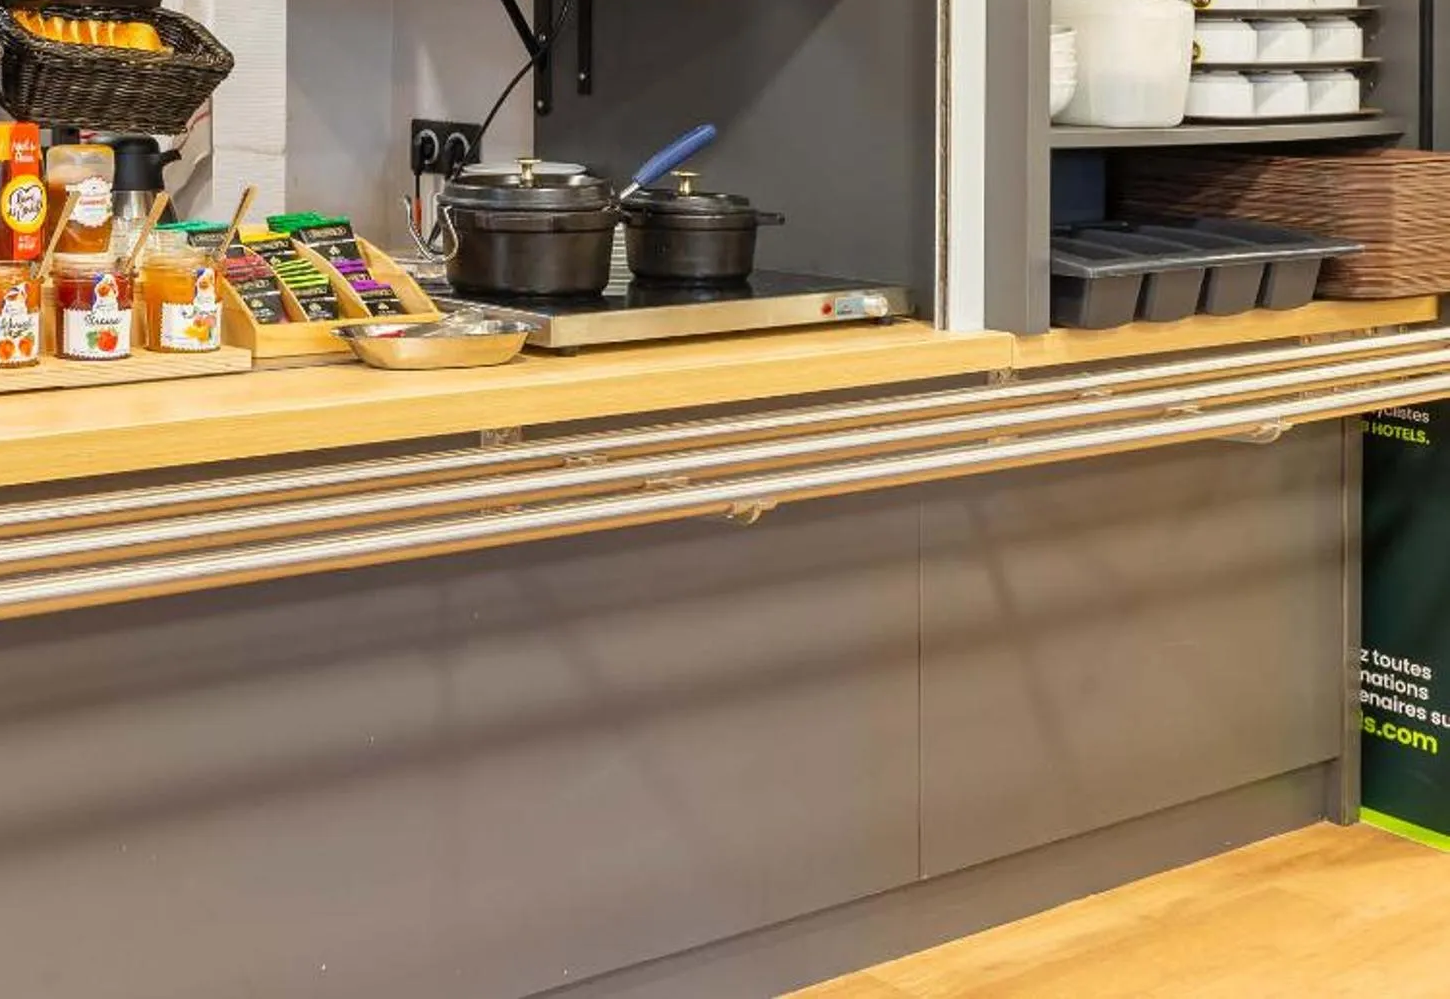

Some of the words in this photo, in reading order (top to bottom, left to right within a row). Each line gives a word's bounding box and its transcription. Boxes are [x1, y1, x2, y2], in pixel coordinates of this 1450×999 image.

[1372, 421, 1431, 446] HOTELS.
[1372, 649, 1432, 680] toutes
[1360, 669, 1429, 700] nations
[1360, 690, 1427, 720] enaires
